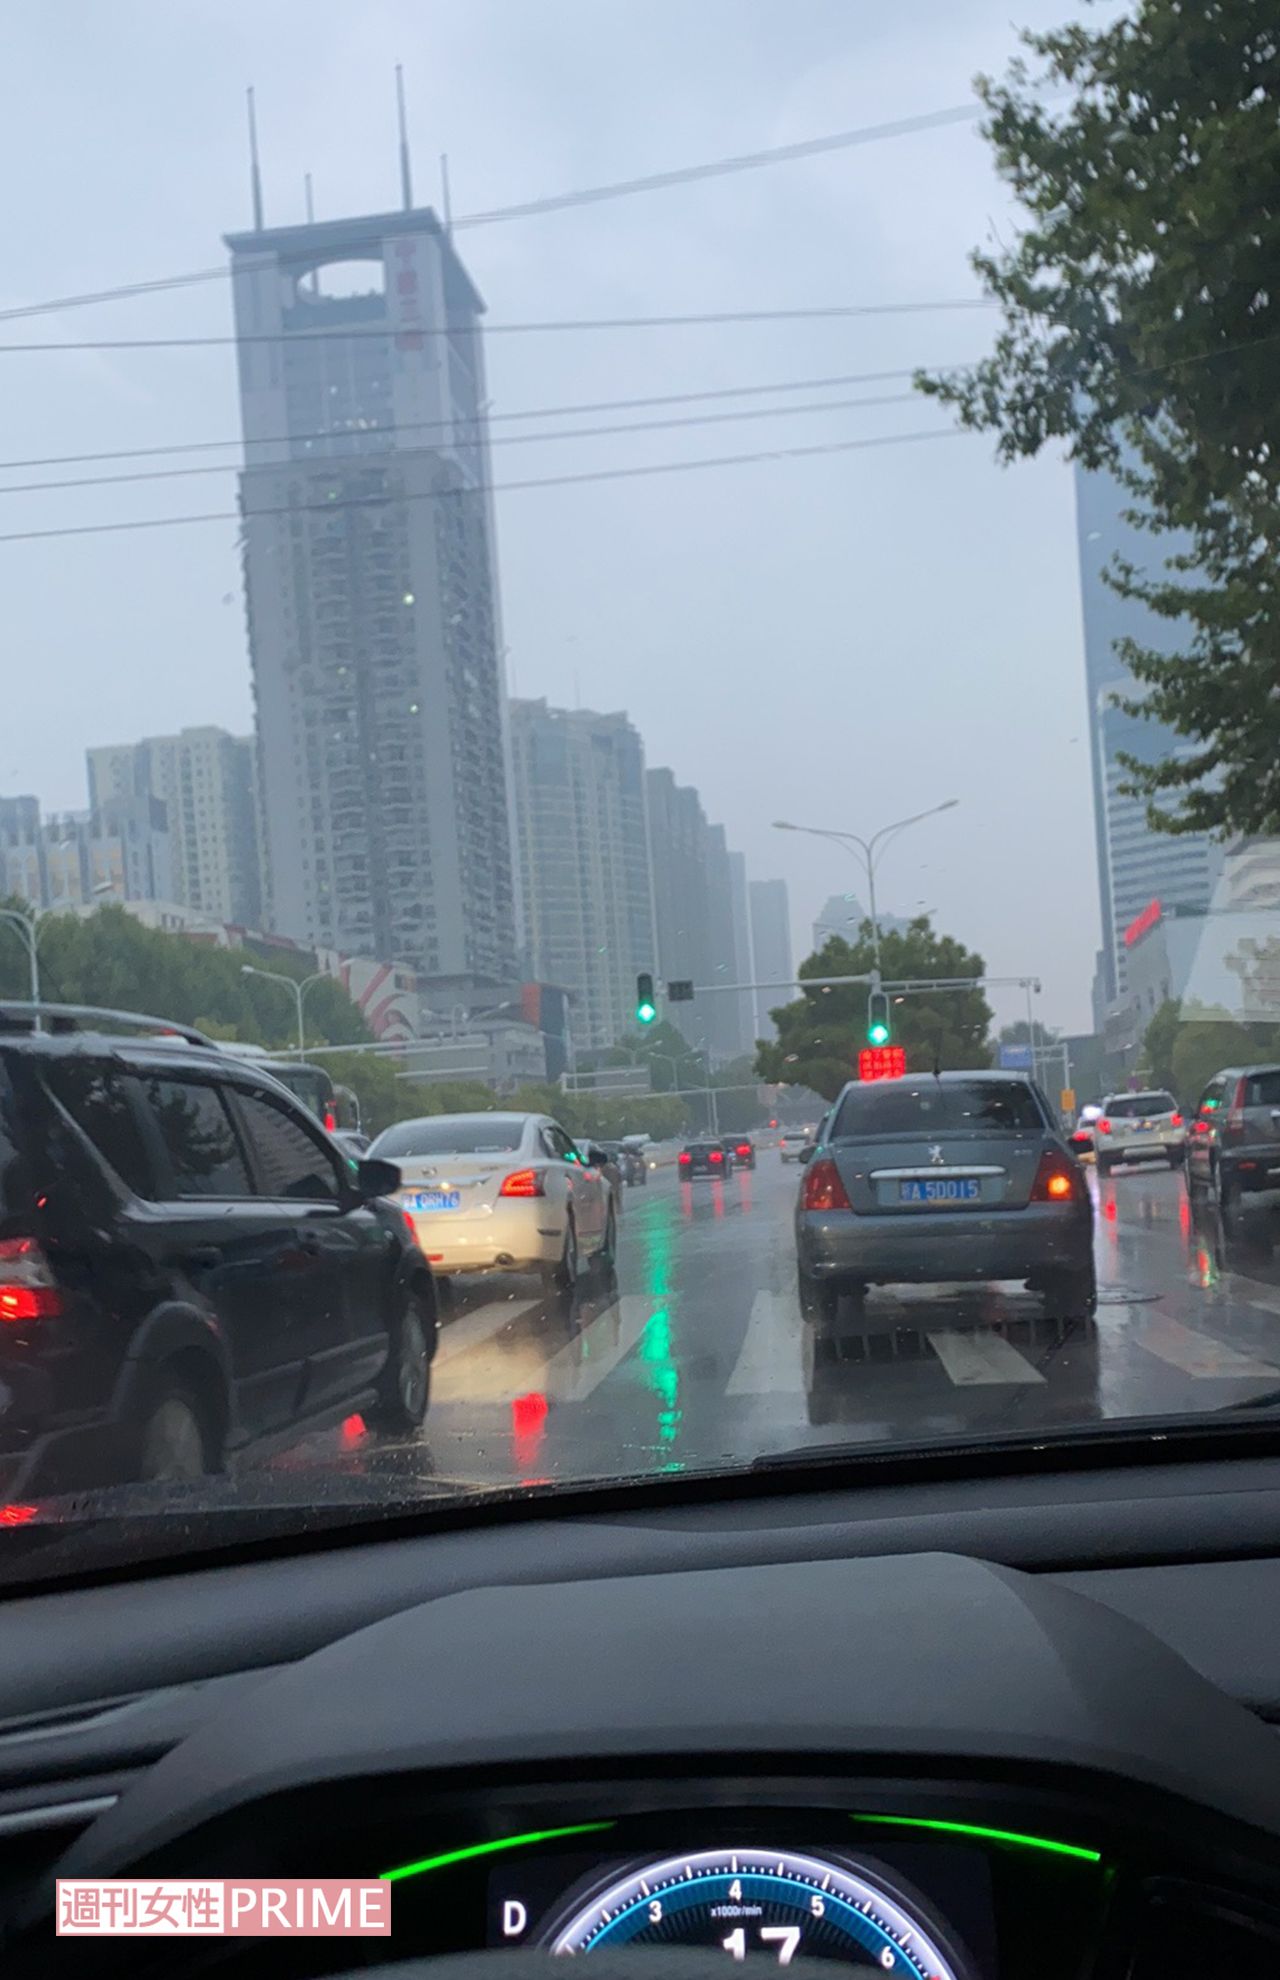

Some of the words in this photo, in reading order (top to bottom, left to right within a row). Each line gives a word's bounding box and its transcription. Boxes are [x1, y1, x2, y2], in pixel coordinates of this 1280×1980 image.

[729, 1879, 742, 1901] 4
[503, 1900, 527, 1935] D
[649, 1900, 662, 1923] 3
[811, 1895, 825, 1918] 5
[881, 1946, 895, 1969] 6
